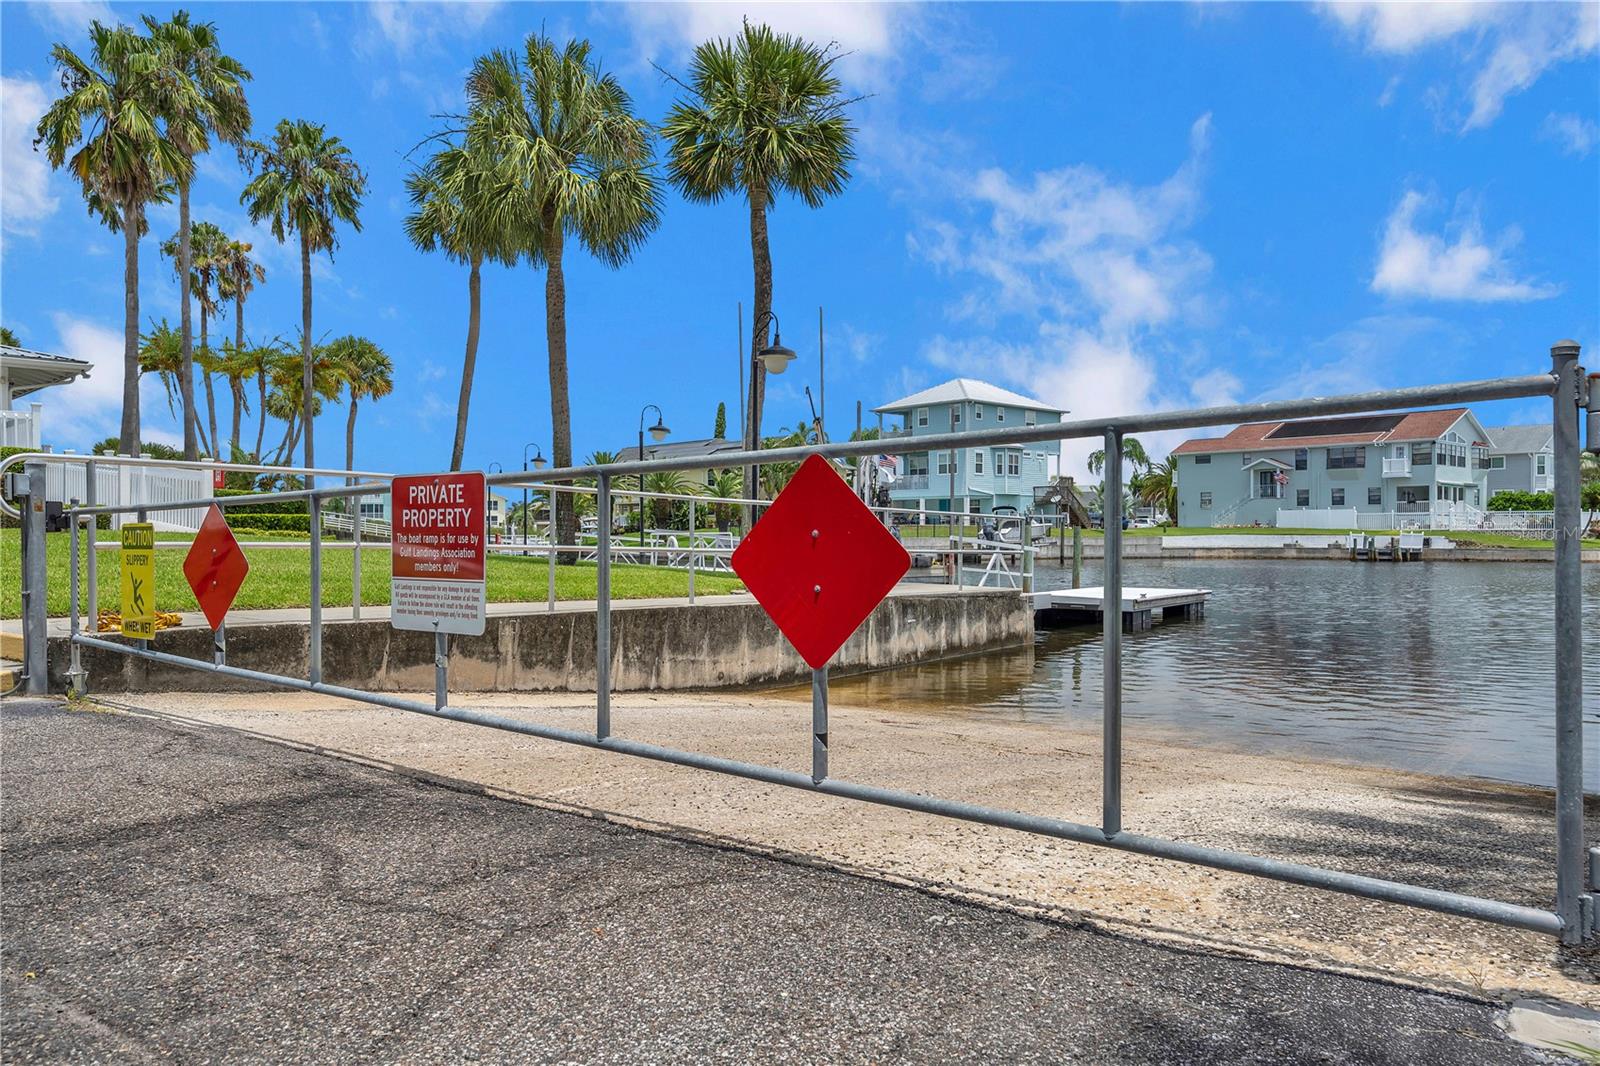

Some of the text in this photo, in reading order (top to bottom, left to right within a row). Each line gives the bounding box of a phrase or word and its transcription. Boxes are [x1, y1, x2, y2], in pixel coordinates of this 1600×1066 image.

[409, 484, 465, 504] PRIVATE
[402, 508, 472, 528] PROPERTY
[124, 530, 152, 546] CAUTION
[396, 532, 479, 546] The boat ramp is for use by
[126, 554, 149, 566] SLIPPERY
[400, 546, 476, 560] Gulf Landings Association
[415, 562, 459, 574] members only!
[140, 622, 151, 634] WET
